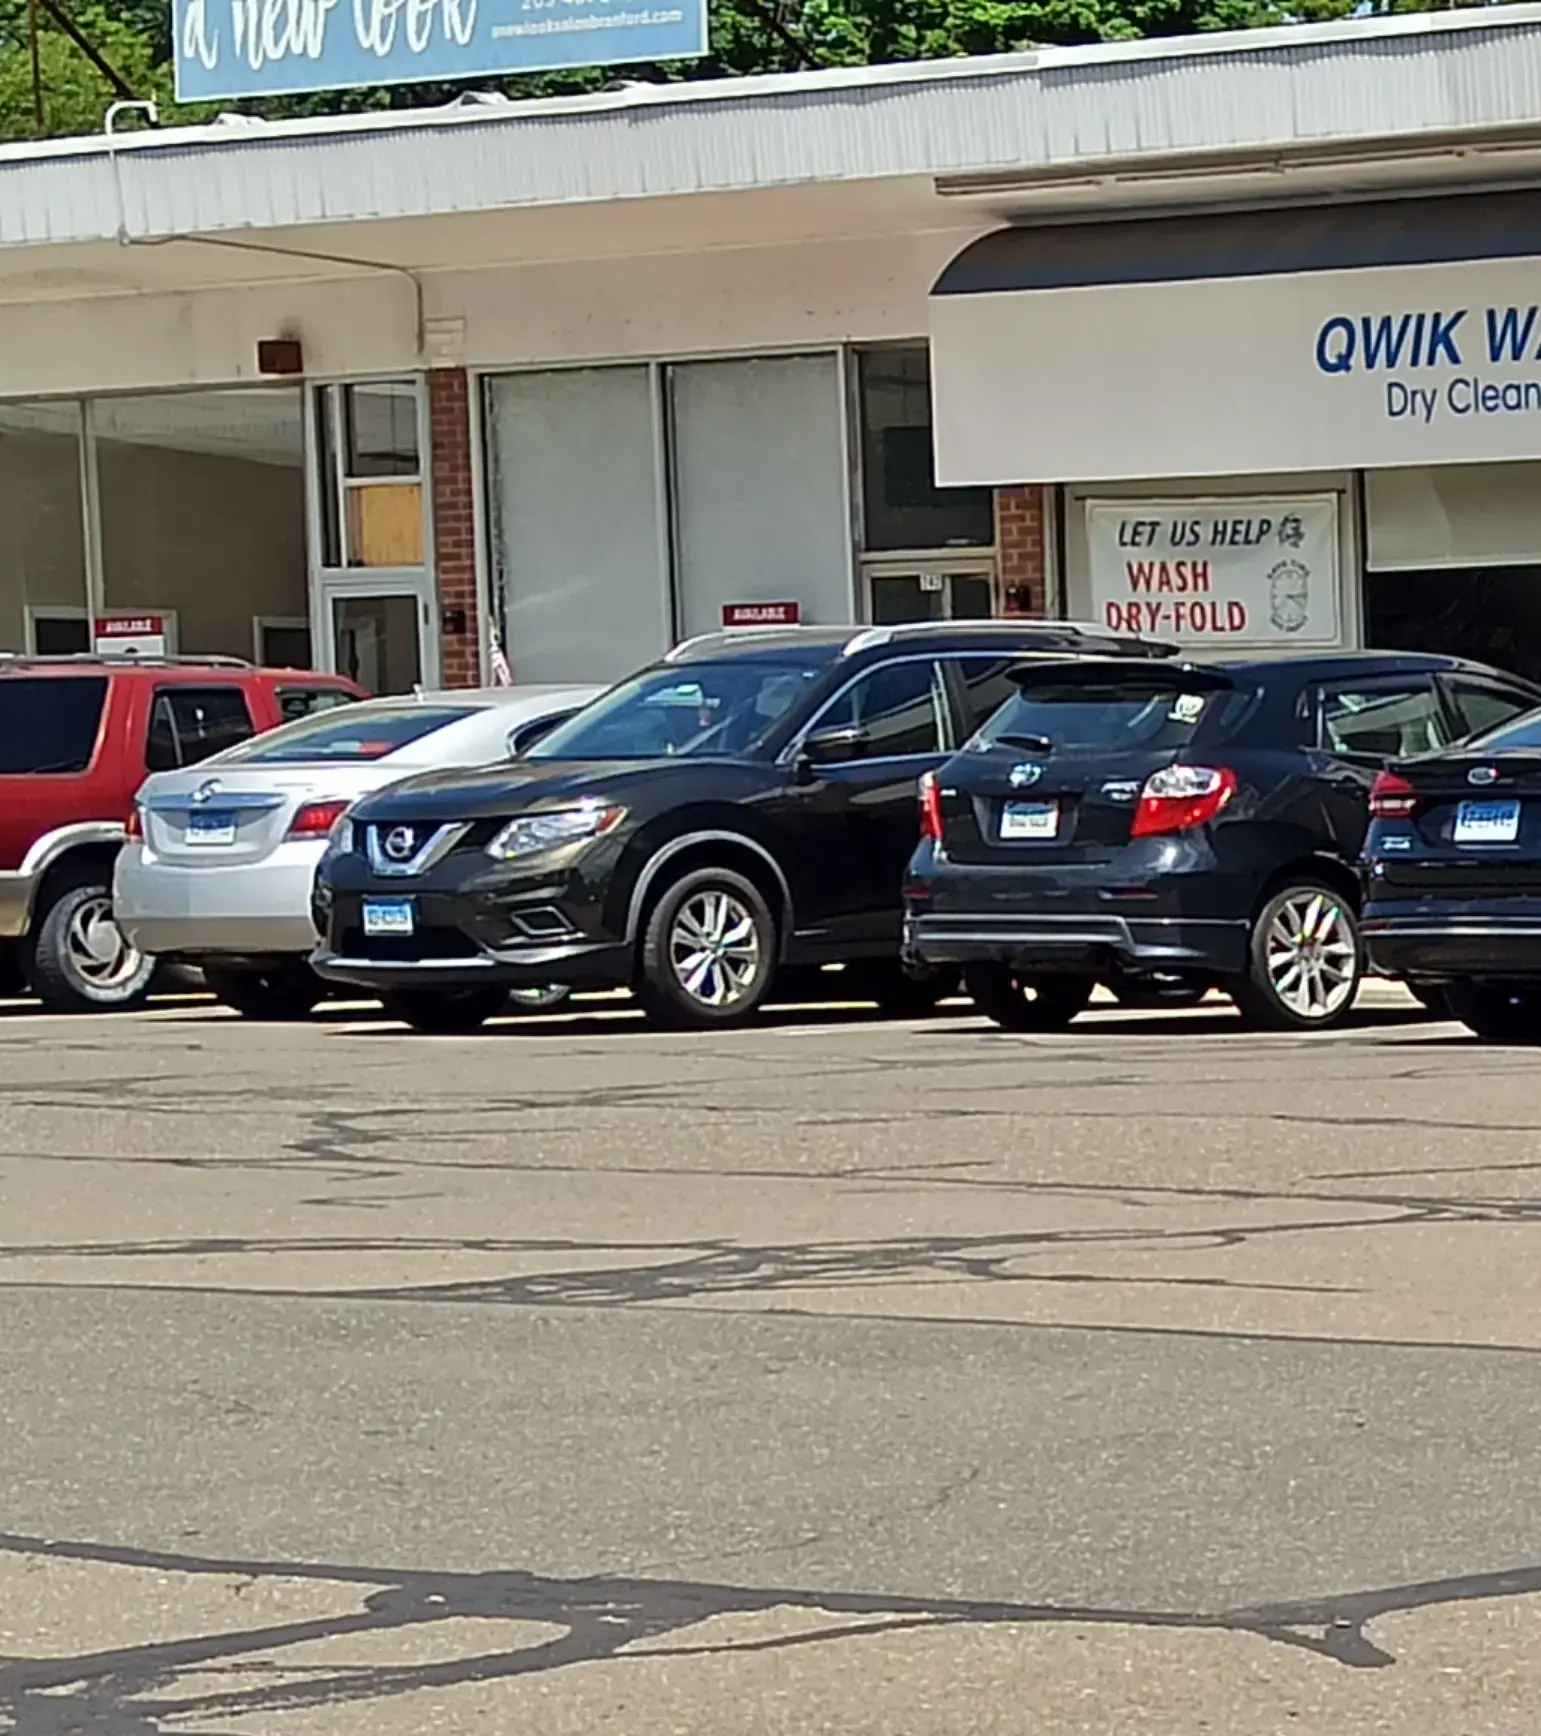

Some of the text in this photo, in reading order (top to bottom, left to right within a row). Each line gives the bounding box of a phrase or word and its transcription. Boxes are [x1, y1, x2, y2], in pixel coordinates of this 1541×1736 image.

[232, 0, 337, 70] new
[1316, 309, 1468, 373] QWIK
[1387, 381, 1438, 424] Dry
[1118, 518, 1273, 547] LET US HELP
[1126, 560, 1210, 593] WASH
[1106, 601, 1246, 633] DRY-FOLD
